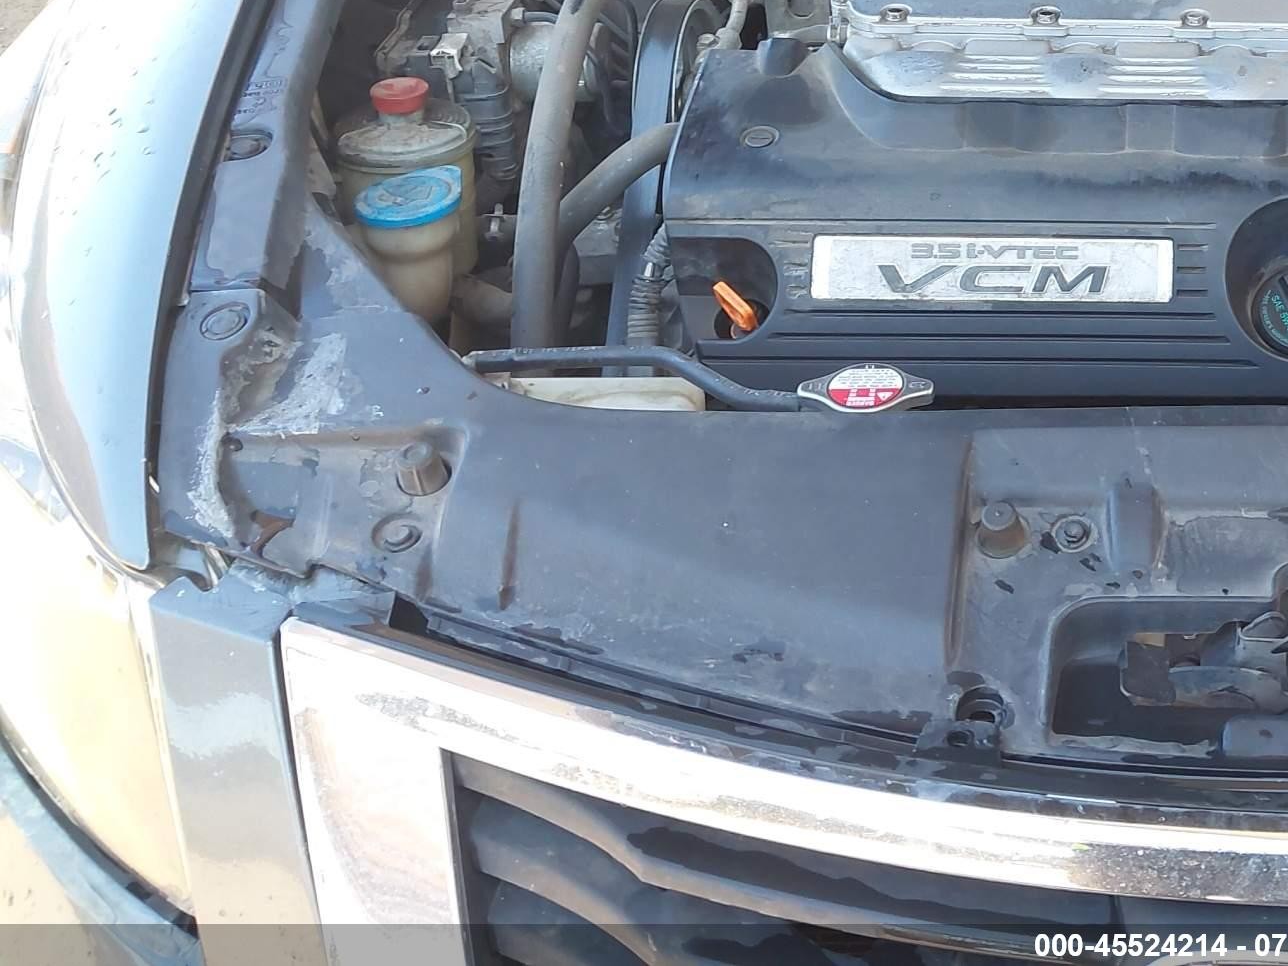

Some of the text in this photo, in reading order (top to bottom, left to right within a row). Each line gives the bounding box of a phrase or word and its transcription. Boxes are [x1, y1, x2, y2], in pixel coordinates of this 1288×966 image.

[910, 242, 1080, 260] 3.5 i-VTEC
[876, 264, 1110, 294] VCM
[1271, 294, 1285, 313] SAE
